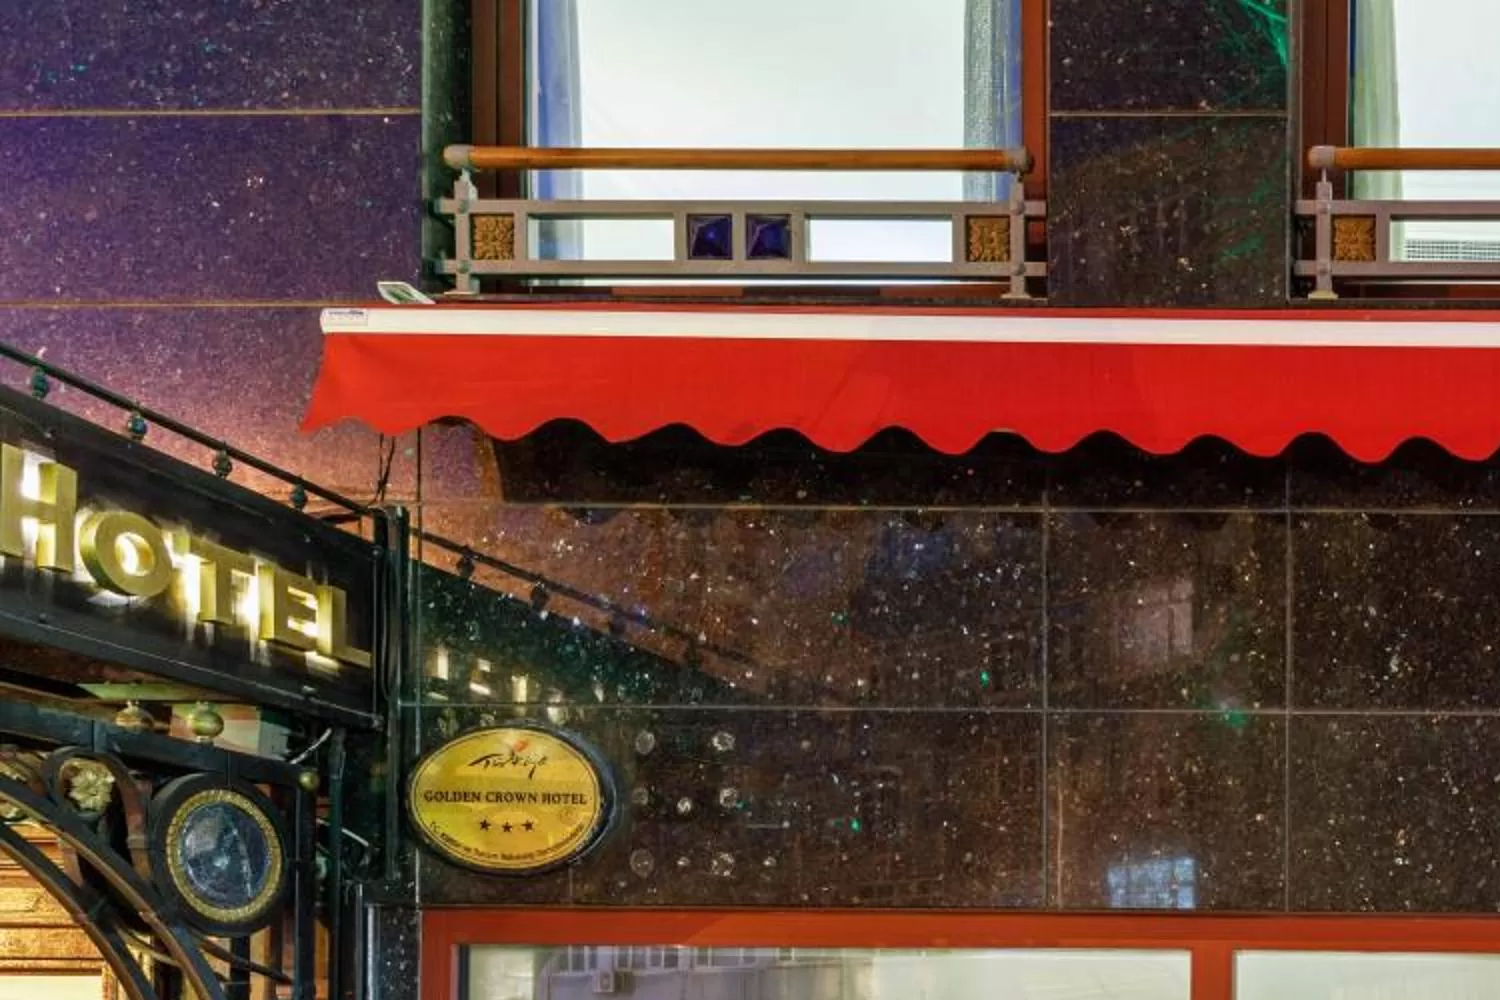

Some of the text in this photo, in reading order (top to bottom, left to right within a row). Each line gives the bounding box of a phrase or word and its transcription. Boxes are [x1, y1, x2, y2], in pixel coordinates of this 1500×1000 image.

[0, 442, 372, 669] HOTEL
[423, 789, 588, 806] GOLDEN CROWN HOTEL
